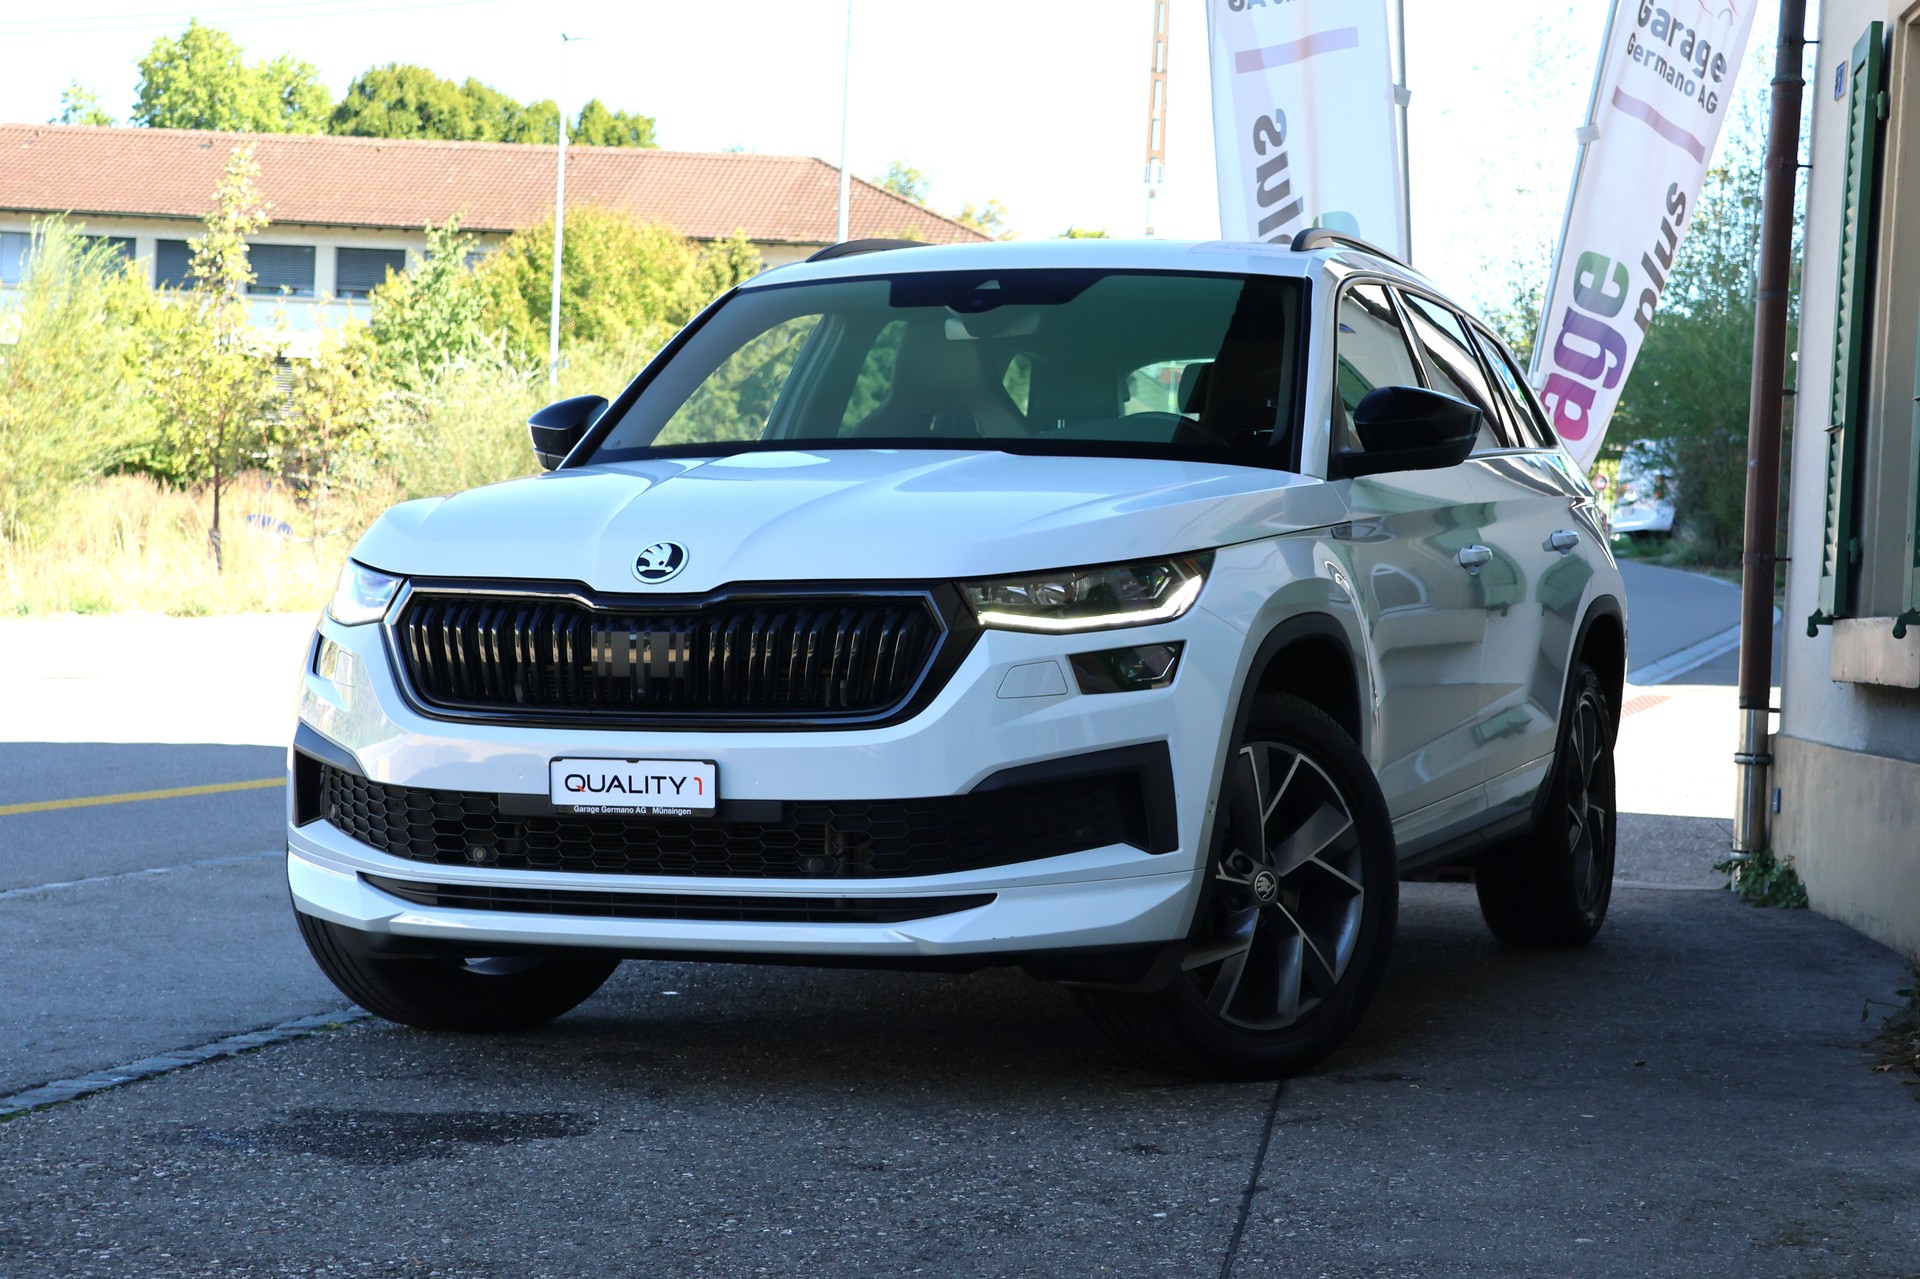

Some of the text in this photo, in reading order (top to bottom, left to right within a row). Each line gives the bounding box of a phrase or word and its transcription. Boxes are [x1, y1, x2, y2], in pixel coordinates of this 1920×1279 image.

[1627, 32, 1718, 114] Germano AG
[1637, 0, 1727, 83] Garage
[1634, 182, 1686, 335] plus
[564, 773, 688, 795] QUALITY
[573, 805, 692, 816] Garage Germano AG Münsingen
